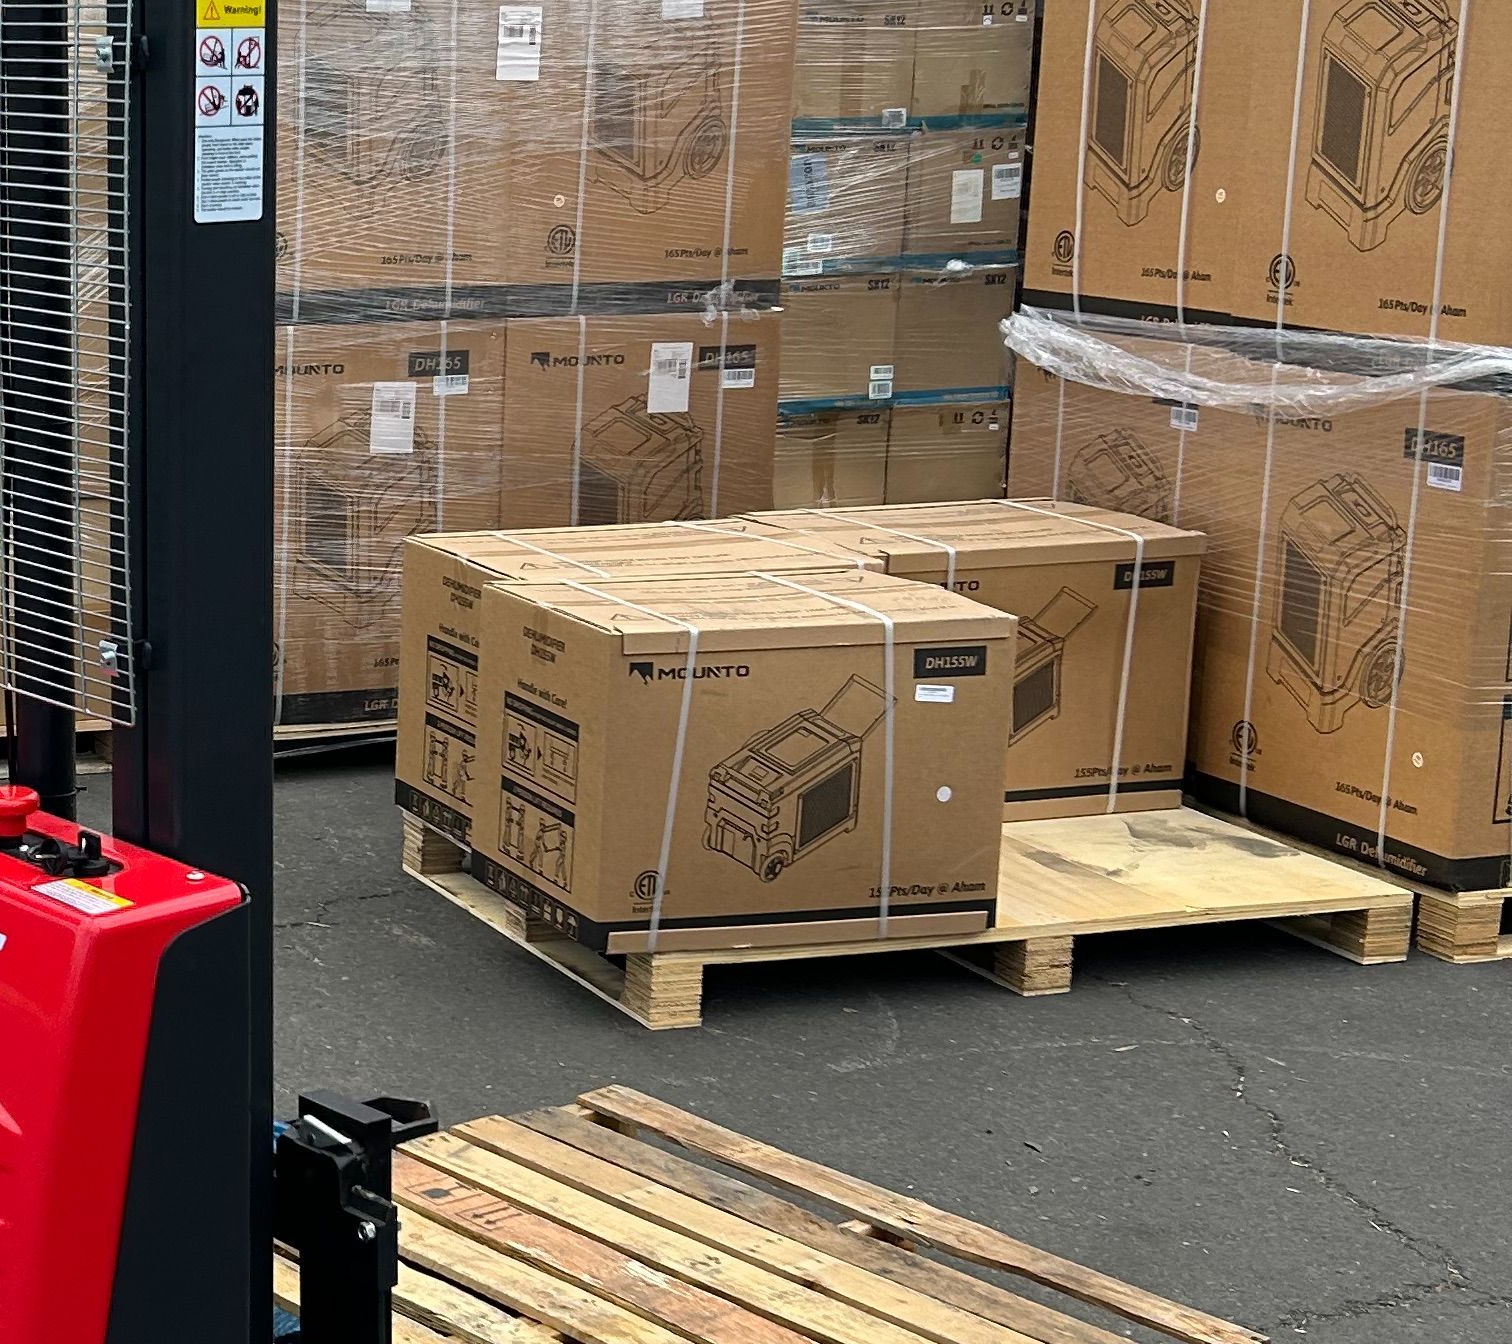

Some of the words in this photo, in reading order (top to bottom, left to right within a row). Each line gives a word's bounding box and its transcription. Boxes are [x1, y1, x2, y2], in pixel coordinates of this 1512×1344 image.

[1124, 568, 1168, 581] D155W
[925, 656, 978, 669] DH155W
[1336, 832, 1358, 850] LGR
[869, 884, 935, 898] 15Pts/Day
